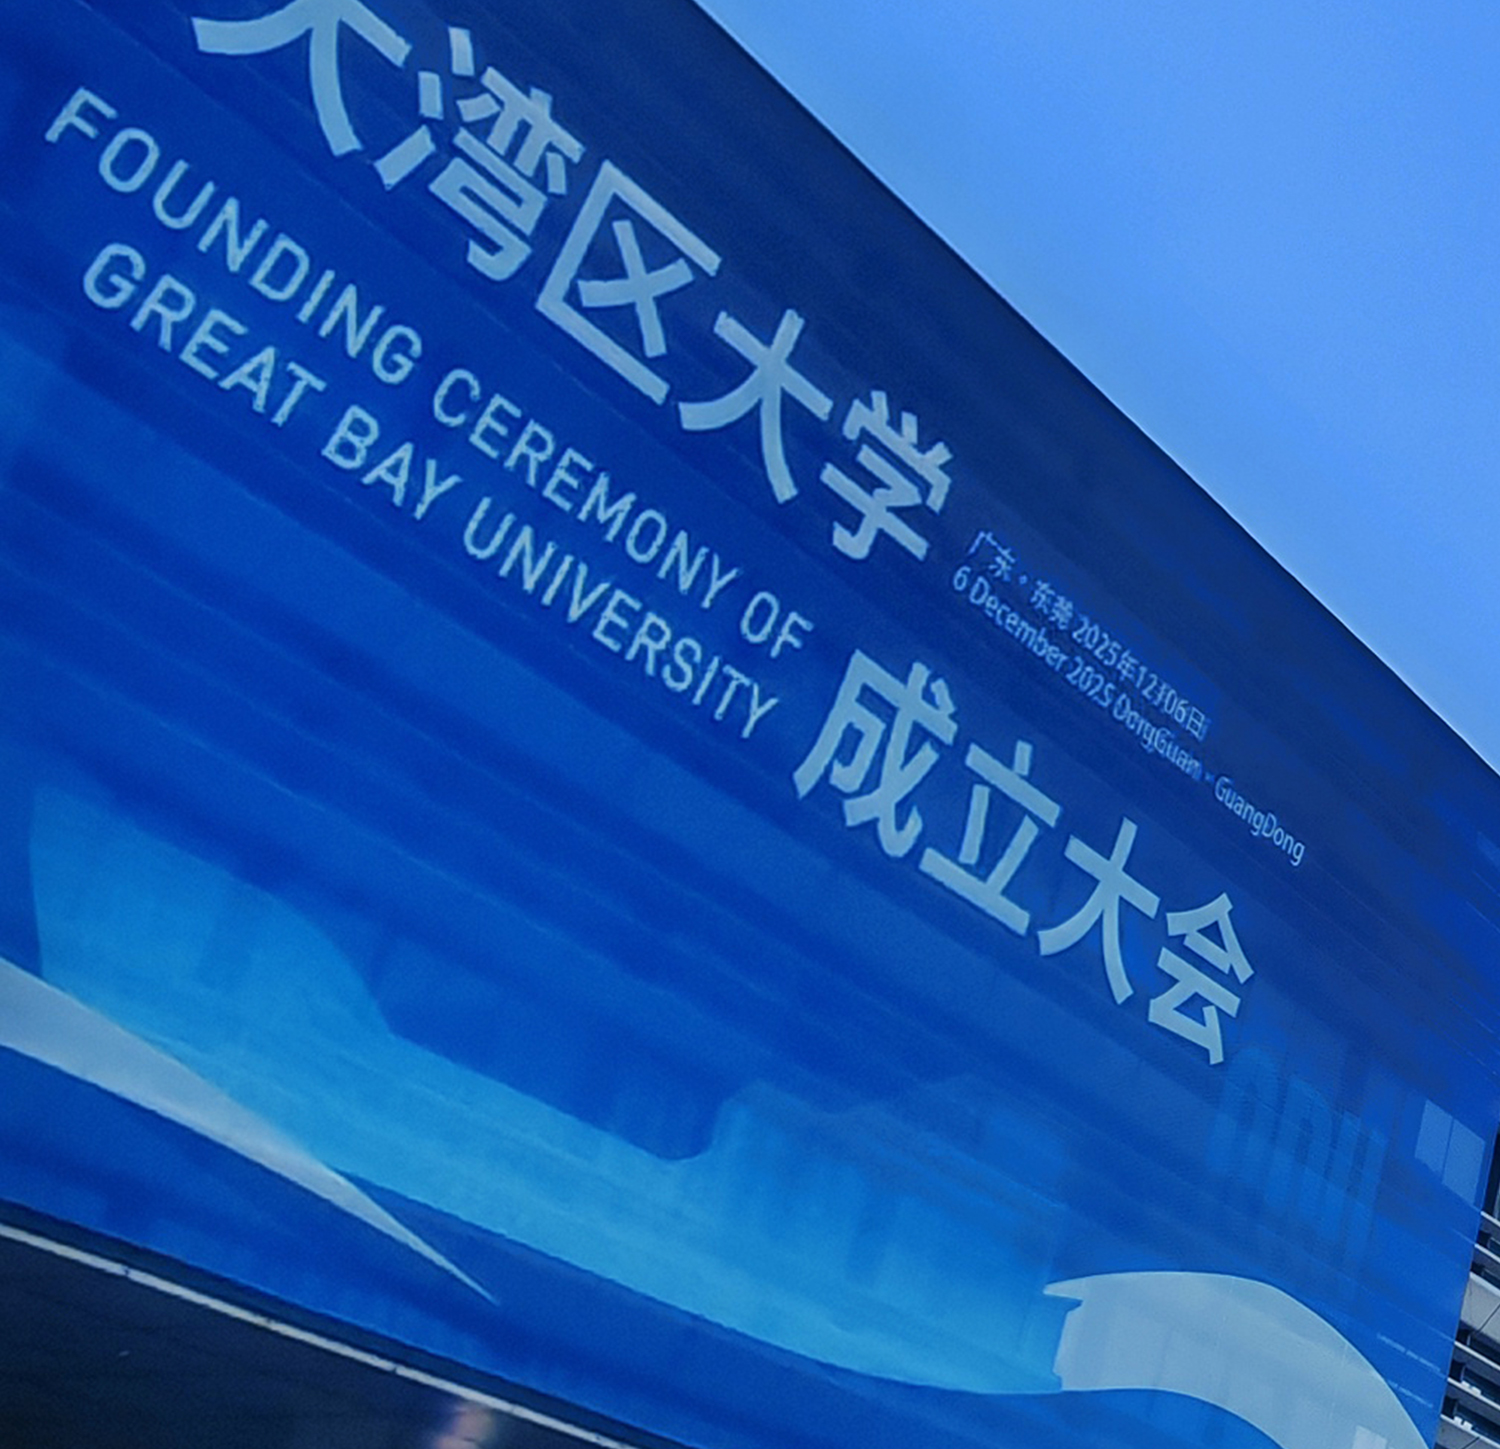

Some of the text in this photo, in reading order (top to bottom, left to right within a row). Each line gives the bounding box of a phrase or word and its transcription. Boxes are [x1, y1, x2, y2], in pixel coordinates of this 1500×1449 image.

[45, 87, 814, 659] FOUNDING CEREMONY OF
[82, 242, 780, 738] GREAT BAY UNIVERSITY
[792, 648, 1255, 1065] 成立大会
[953, 565, 971, 591] 6
[969, 576, 1069, 673] December
[1066, 655, 1116, 708] 2025
[1214, 775, 1305, 866] GuangDong
